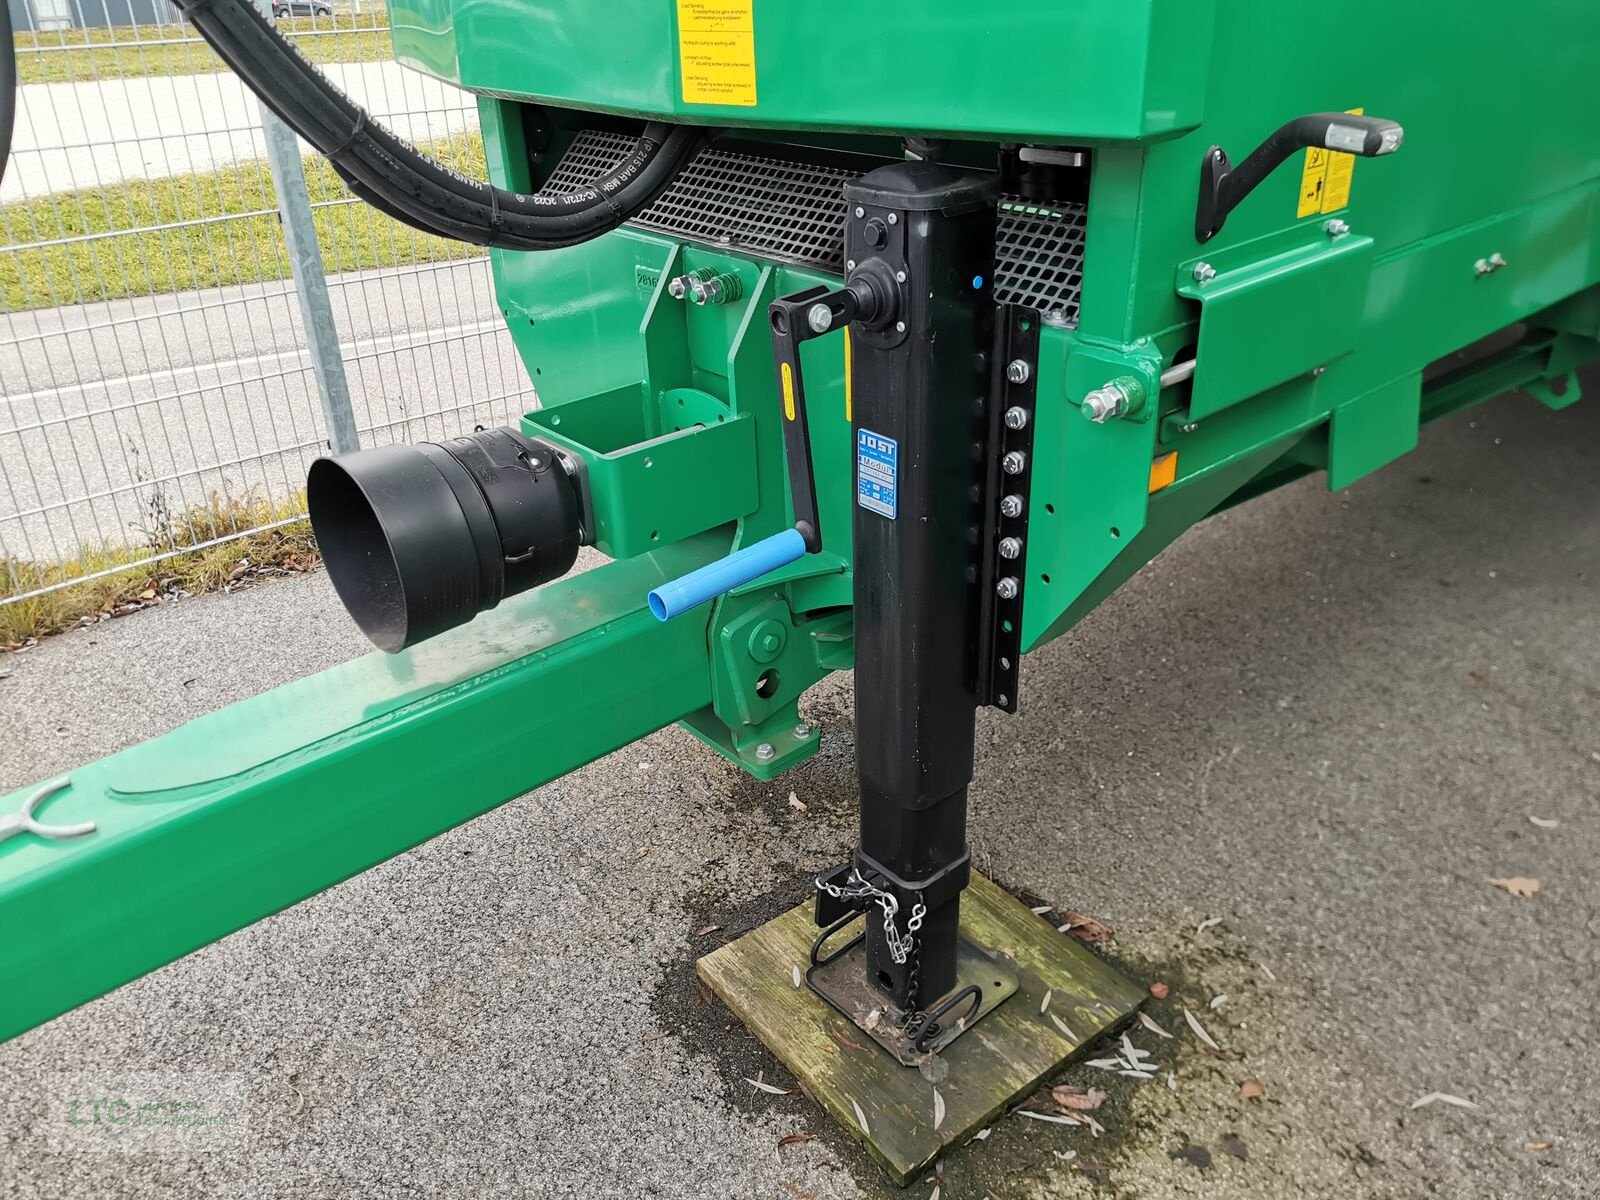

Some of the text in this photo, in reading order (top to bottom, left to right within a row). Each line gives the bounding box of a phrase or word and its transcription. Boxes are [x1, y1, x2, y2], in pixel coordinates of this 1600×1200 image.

[636, 151, 648, 168] 215
[621, 164, 638, 182] BAR
[637, 274, 660, 288] 2816
[860, 434, 895, 455] JOST
